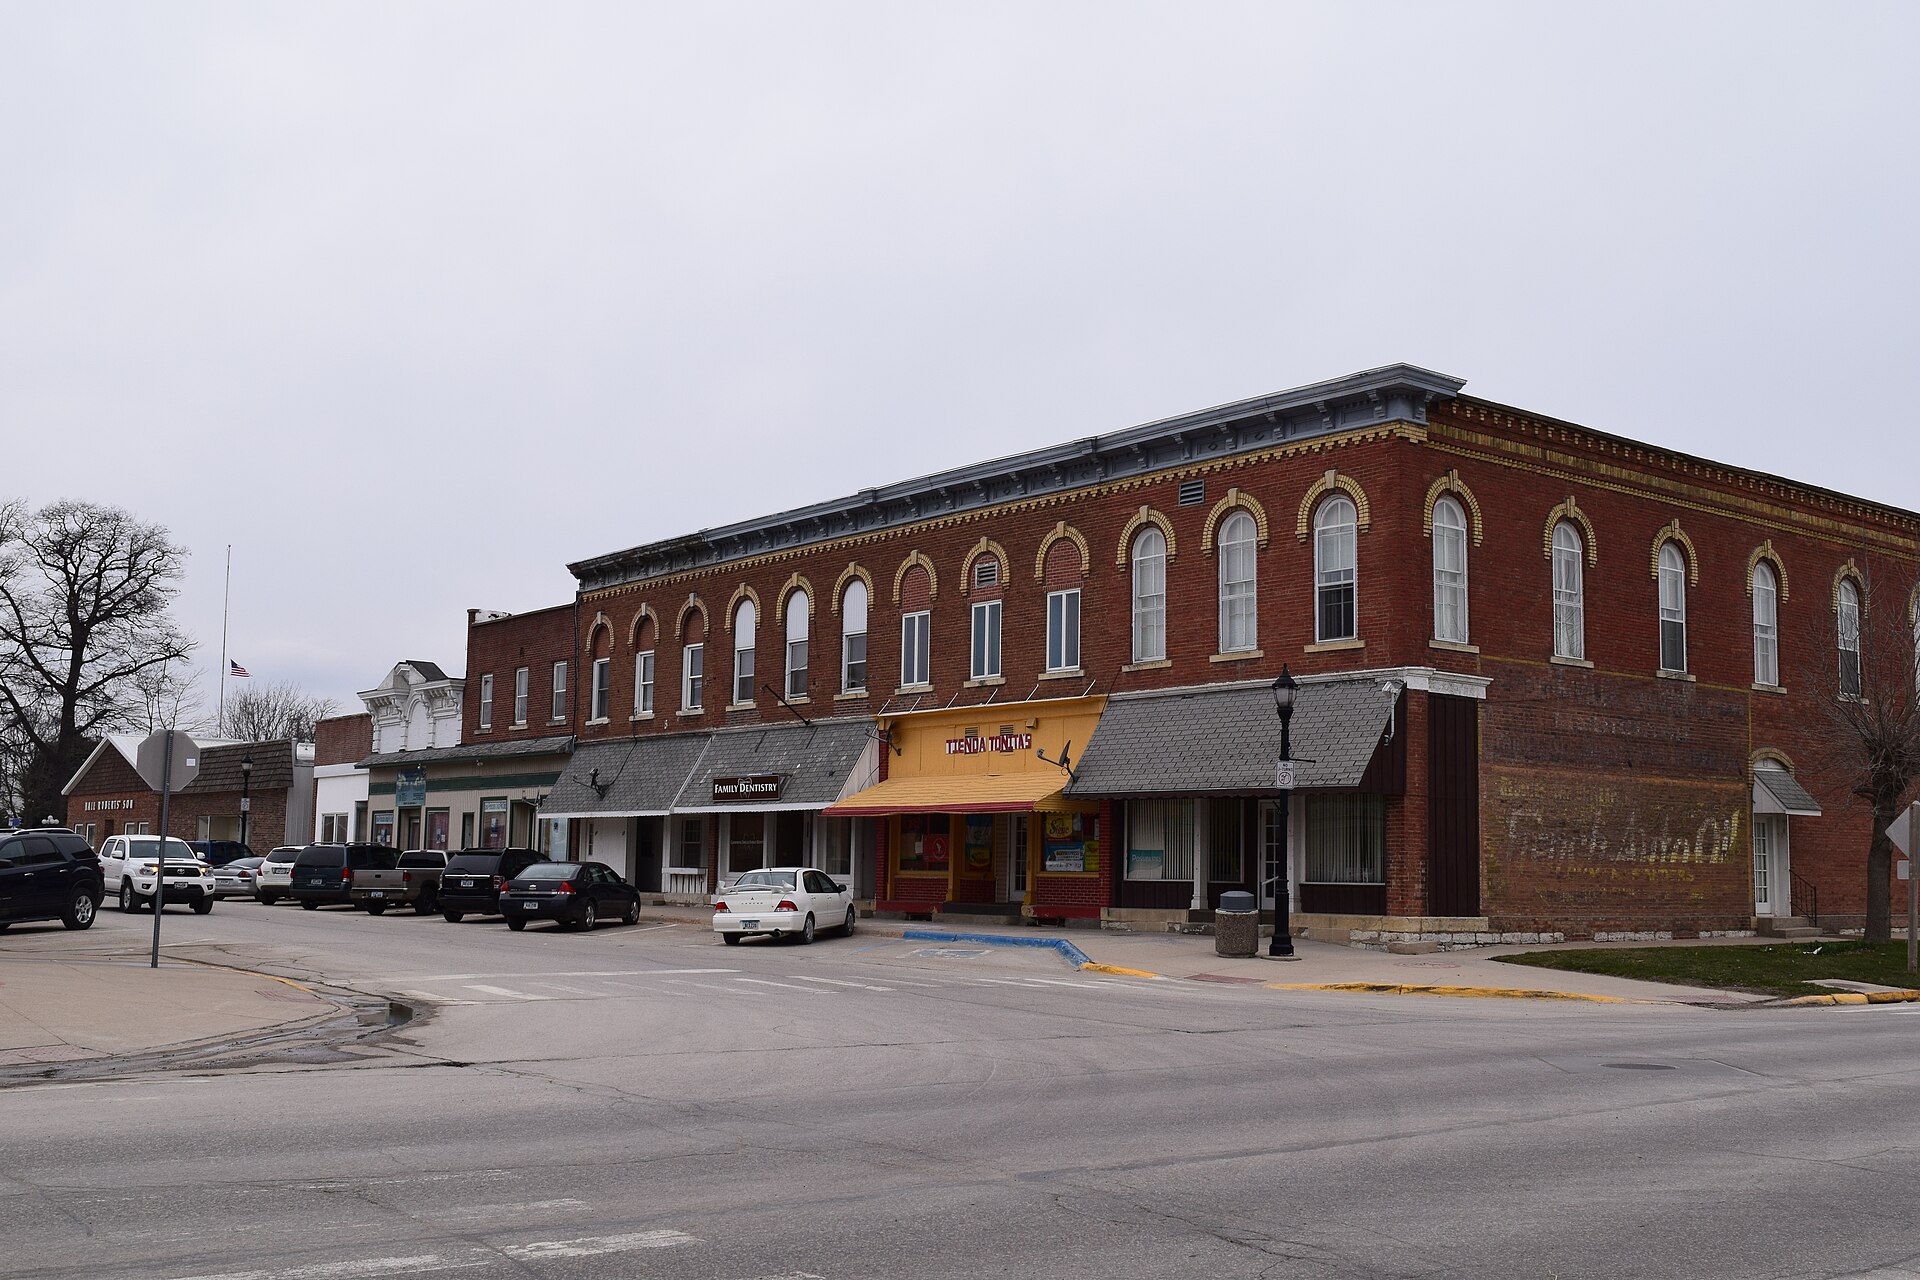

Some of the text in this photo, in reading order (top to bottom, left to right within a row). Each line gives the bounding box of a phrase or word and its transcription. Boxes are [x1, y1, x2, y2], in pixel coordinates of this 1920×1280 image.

[946, 737, 986, 754] TIENDA
[714, 783, 777, 794] FAMILY DENTISTRY
